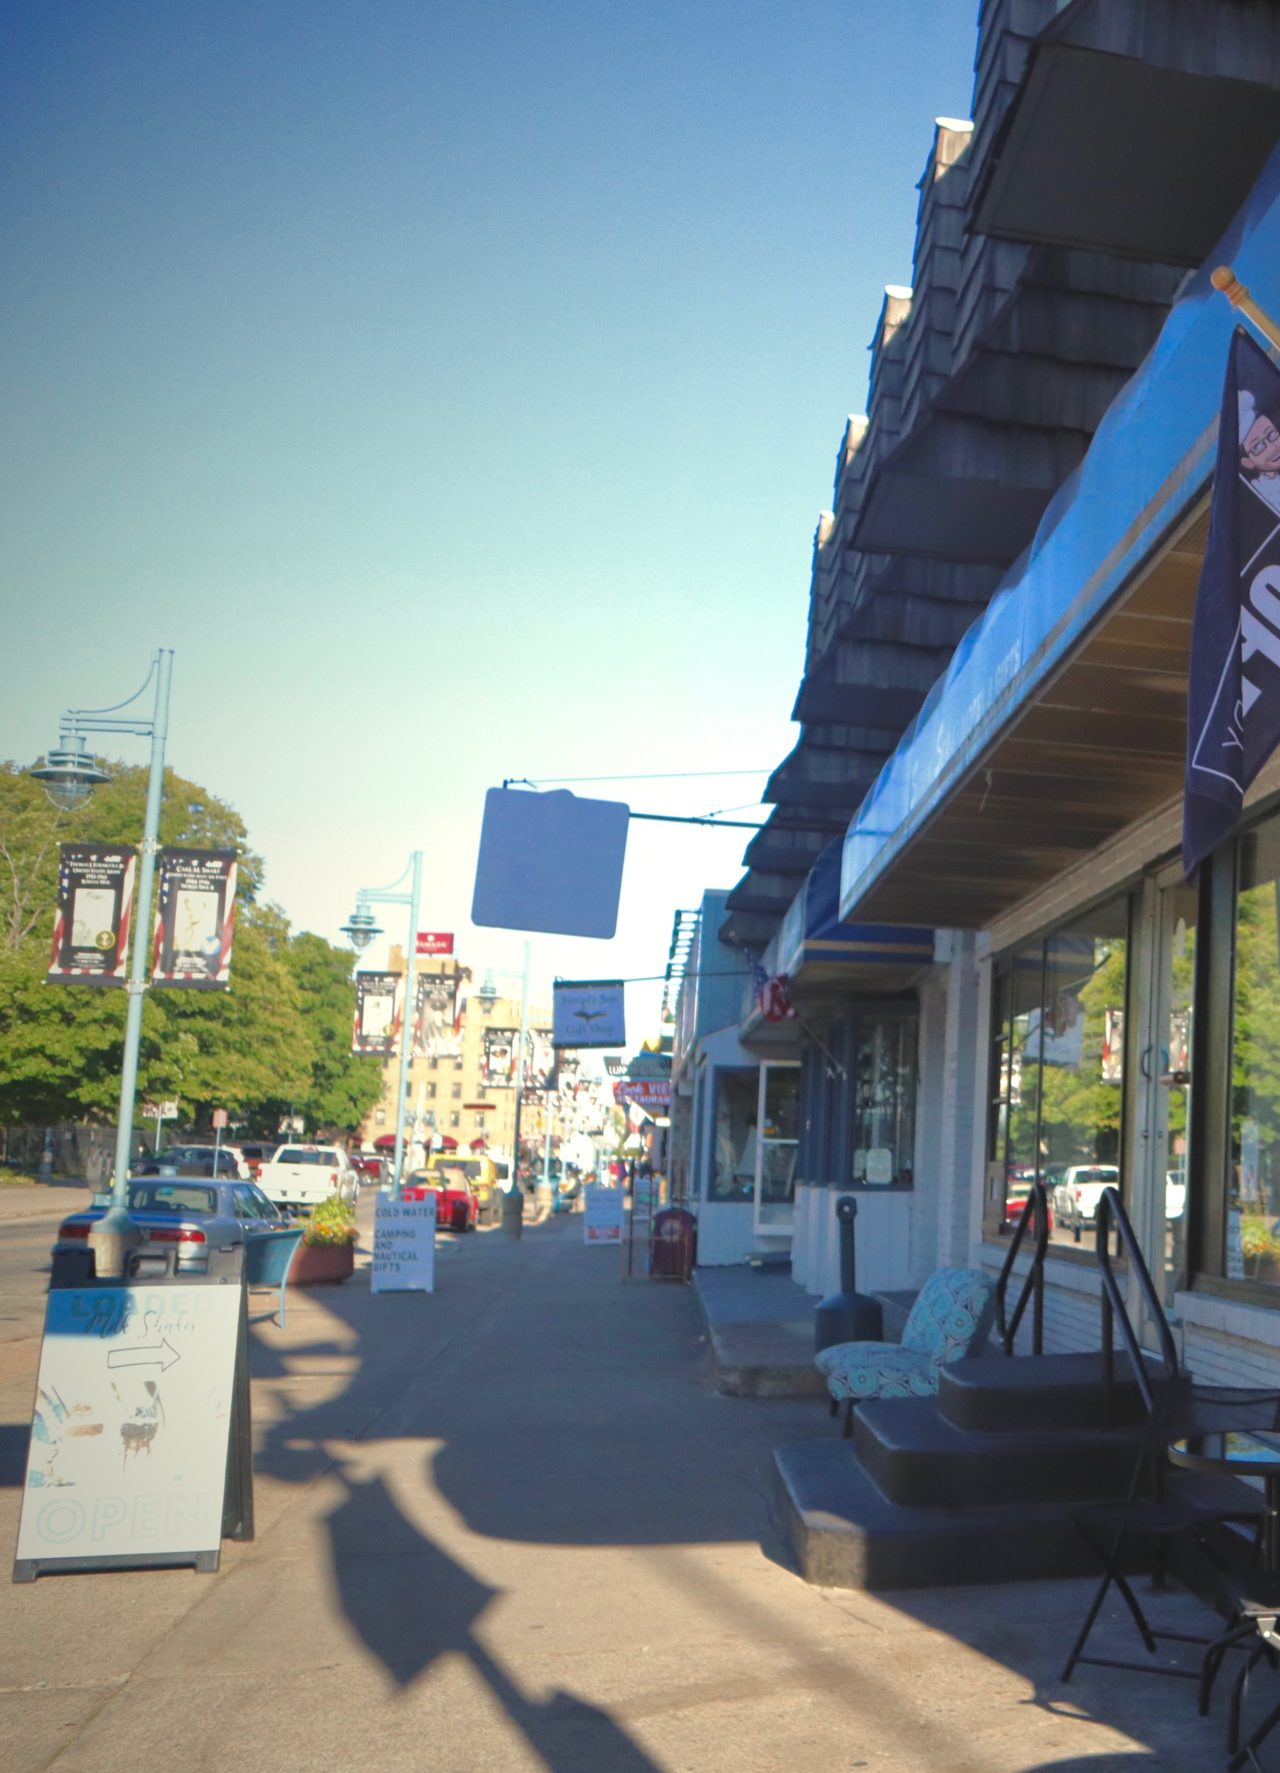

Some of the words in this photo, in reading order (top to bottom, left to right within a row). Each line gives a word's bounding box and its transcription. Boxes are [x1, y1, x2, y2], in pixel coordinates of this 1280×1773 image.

[376, 1207, 400, 1218] COLD
[402, 1207, 436, 1218] WATER
[375, 1230, 416, 1240] CAMPING
[375, 1240, 392, 1250] AND
[374, 1251, 419, 1261] NAUTICAL
[373, 1262, 401, 1273] GIFTS
[71, 1293, 217, 1319] LOADED
[35, 1493, 209, 1545] OPEN
